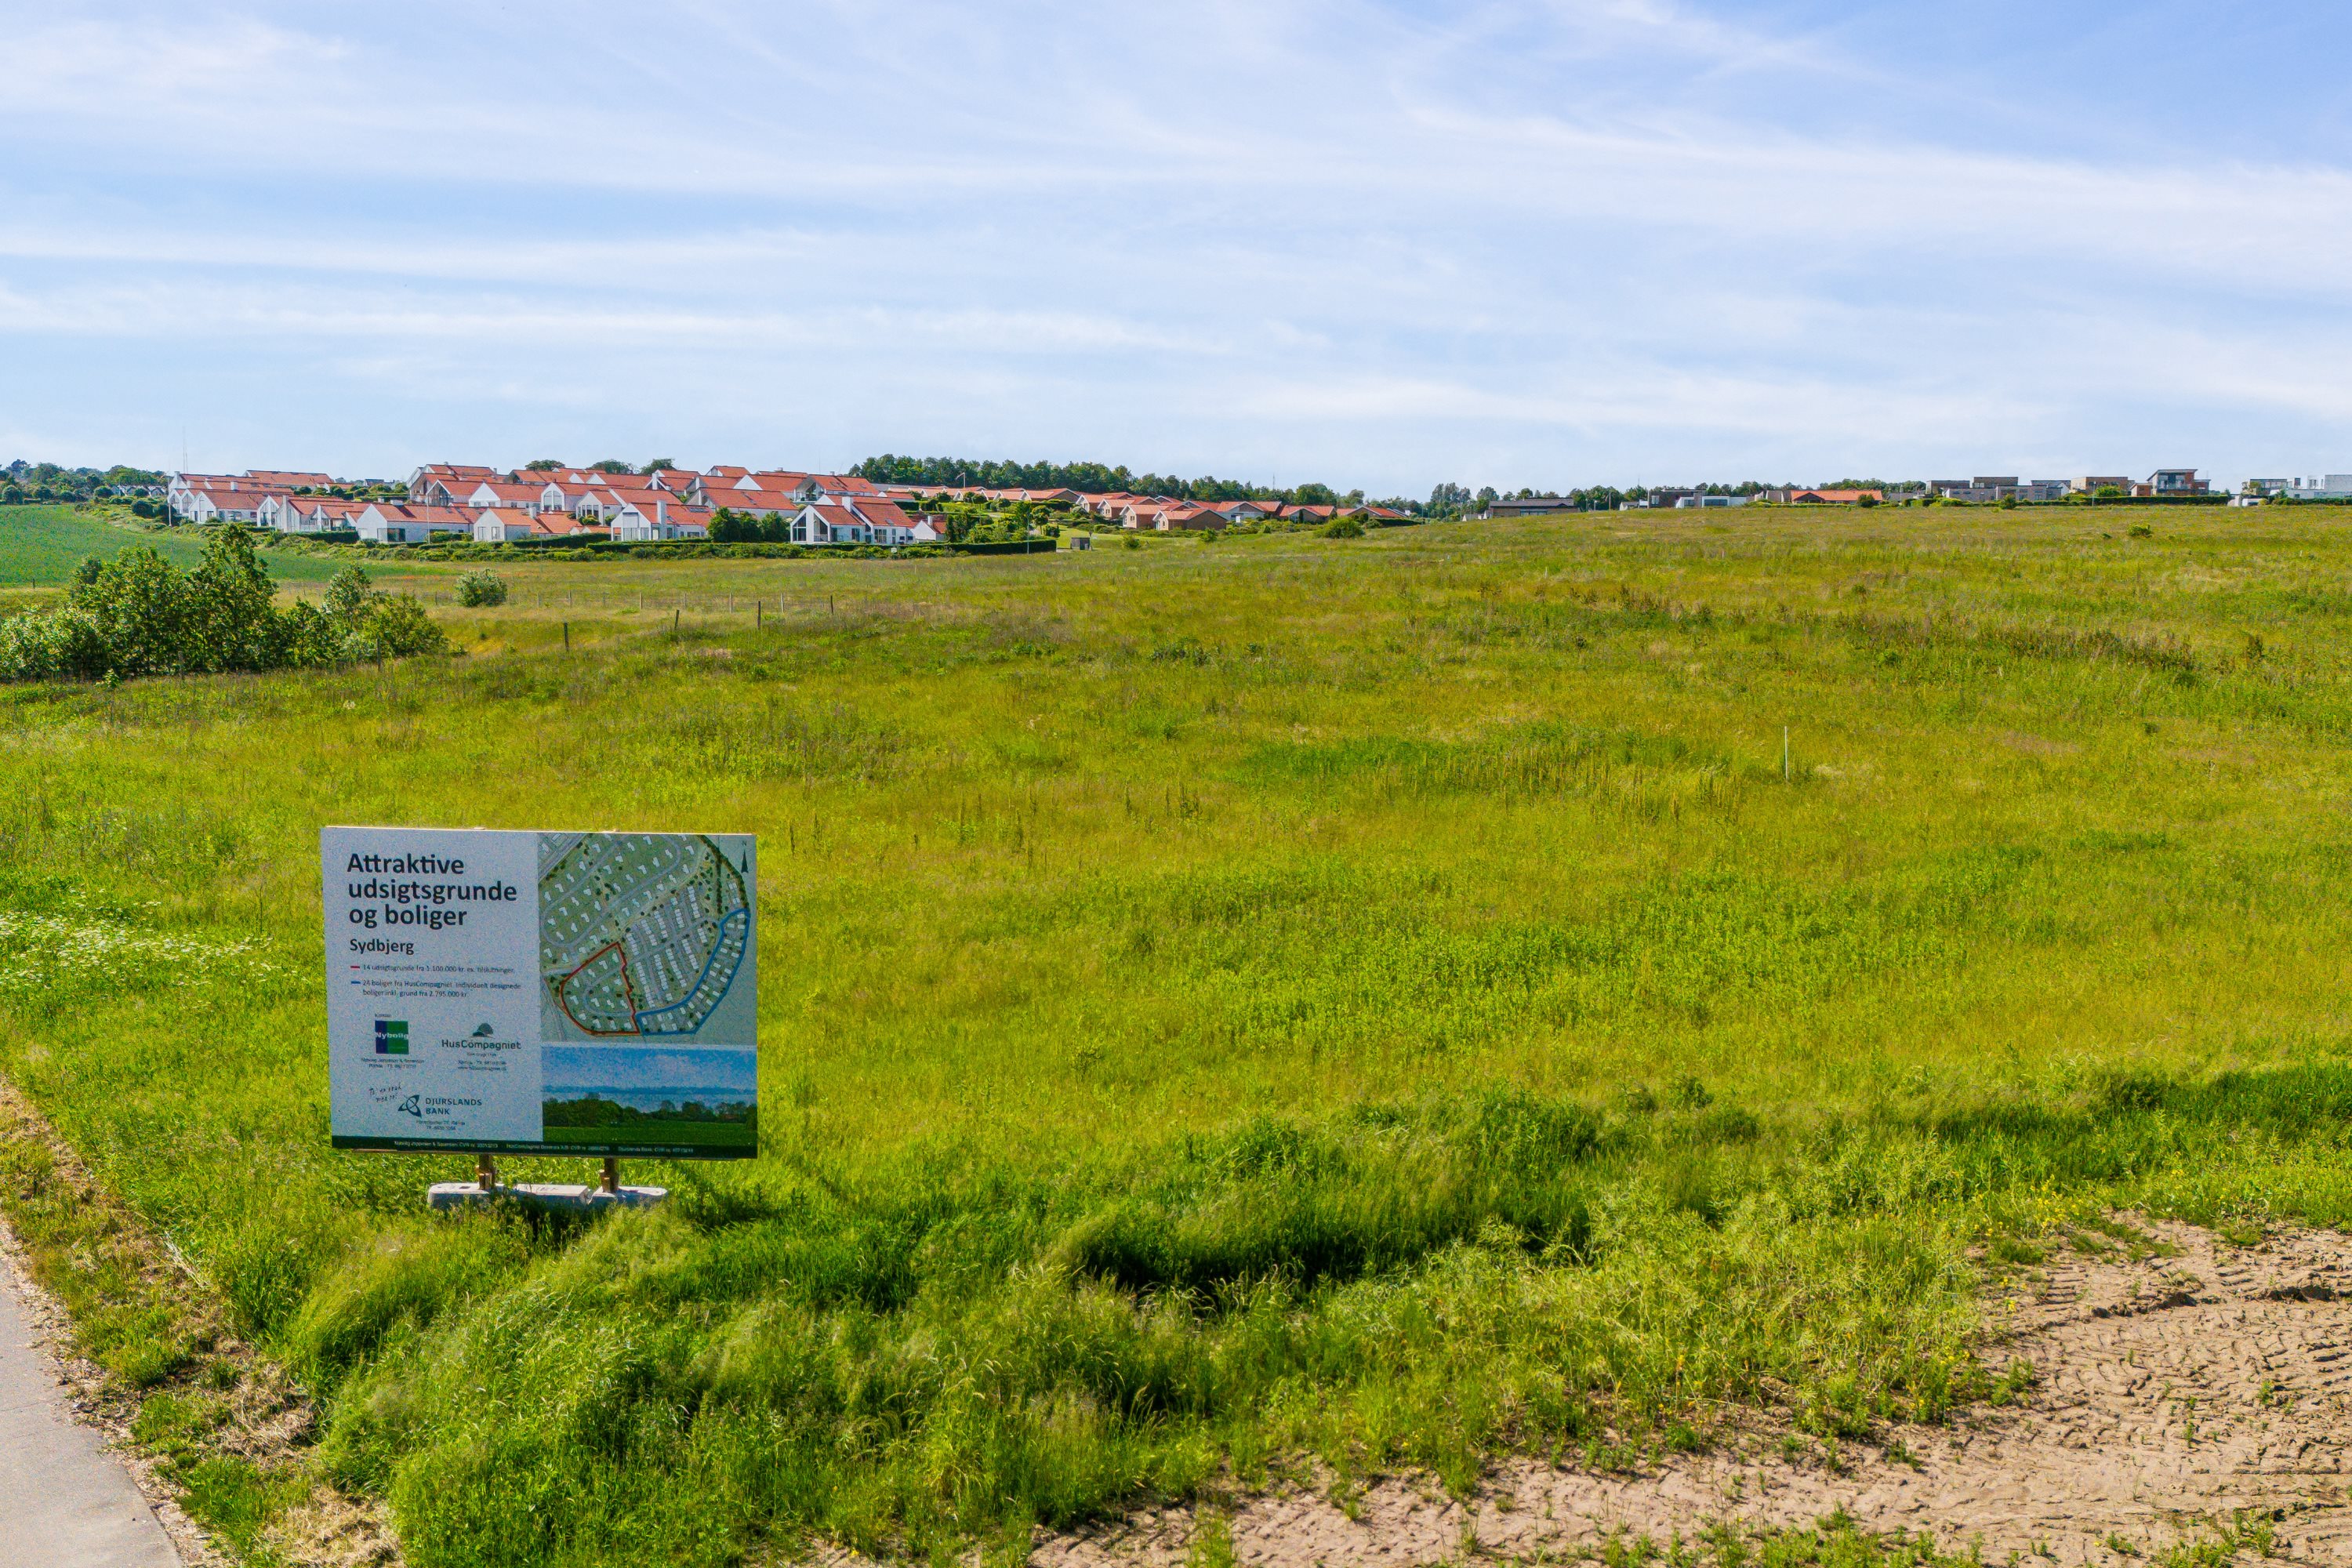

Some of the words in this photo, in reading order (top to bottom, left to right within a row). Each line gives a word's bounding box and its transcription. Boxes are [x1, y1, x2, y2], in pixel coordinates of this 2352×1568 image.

[347, 853, 464, 874] Attraktive
[348, 878, 517, 905] udsigtsgrunde
[349, 908, 377, 929] og
[384, 904, 467, 930] boliger
[349, 938, 414, 956] Sydbjerg
[376, 1031, 410, 1040] Nybolig
[441, 1039, 522, 1051] HusCompagniet
[425, 1097, 483, 1106] DJURSLANDS
[425, 1107, 450, 1116] BANK
